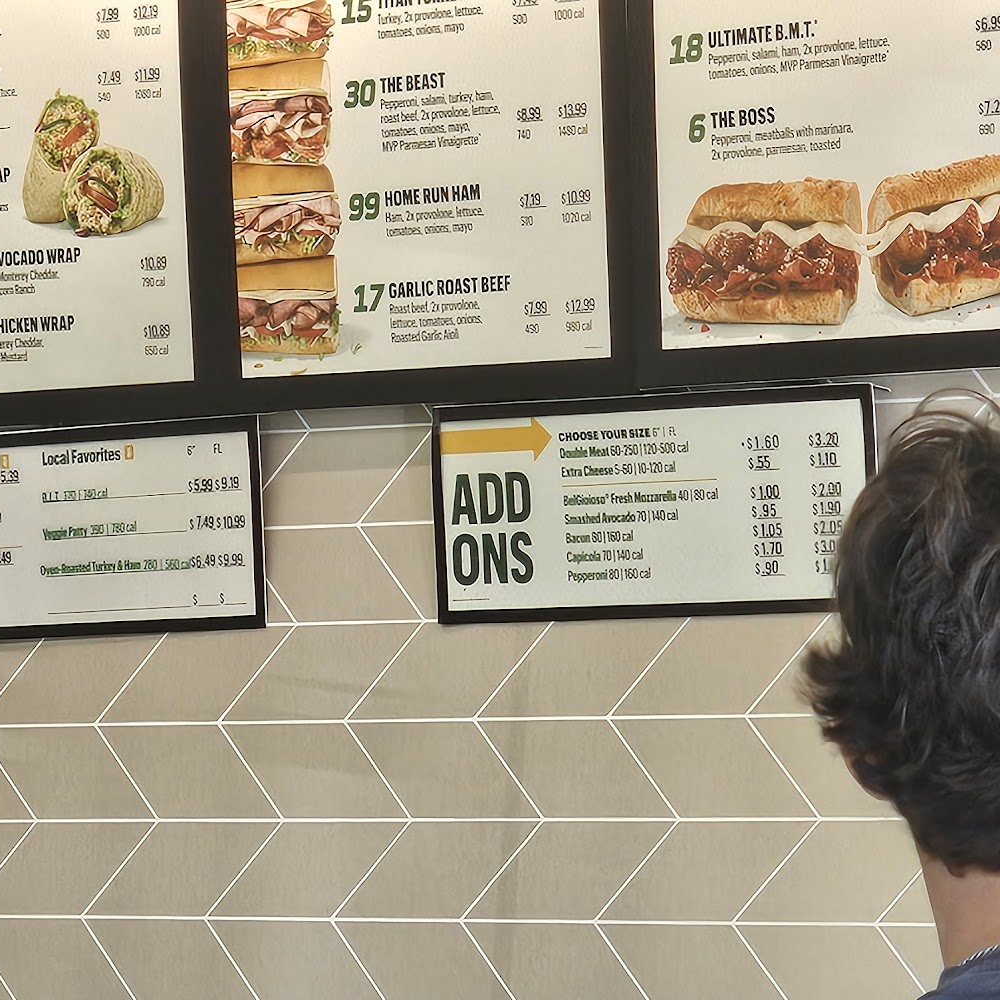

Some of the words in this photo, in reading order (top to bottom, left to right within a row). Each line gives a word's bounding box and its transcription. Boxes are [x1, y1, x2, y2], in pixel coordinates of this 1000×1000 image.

[96, 8, 119, 22] $7.99
[342, 0, 372, 24] 15
[669, 33, 704, 65] 18
[708, 25, 772, 49] ULTIMATE
[803, 44, 813, 55] 2x
[780, 61, 799, 73] MVP
[799, 58, 840, 70] Parmesan
[98, 70, 120, 85] $7.49
[135, 68, 160, 82] $11.99
[344, 79, 376, 109] 30
[380, 76, 403, 94] THE
[406, 72, 446, 91] BEAST
[517, 107, 541, 121] $8.99
[558, 103, 587, 118] $13.99
[688, 114, 706, 144] 6
[710, 111, 735, 129] THE
[738, 107, 775, 126] BOSS
[796, 126, 814, 138] with
[711, 149, 722, 161] 2x
[809, 138, 841, 151] toasted
[349, 192, 380, 221] 99
[385, 189, 420, 207] HOME
[423, 186, 449, 203] RUN
[452, 184, 480, 201] HAM
[561, 190, 591, 205] $10.99
[46, 247, 81, 264] WRAP
[353, 284, 385, 312] 17
[389, 281, 434, 299] GARLIC
[437, 277, 478, 295] ROAST
[481, 275, 511, 293] BEEF
[524, 301, 548, 316] $7.99
[566, 298, 595, 313] $12.99
[40, 315, 74, 332] WRAP
[558, 431, 598, 442] CHOOSE
[600, 430, 628, 440] YOUR
[629, 428, 650, 438] SIZE
[747, 435, 779, 450] $1.60
[808, 432, 839, 447] $3.20
[213, 443, 222, 454] FL
[677, 441, 689, 453] cal
[42, 449, 70, 466] Local
[71, 447, 121, 464] Favorites
[810, 452, 837, 467] $1.10
[561, 467, 582, 477] Extra
[583, 466, 614, 476] Cheese
[215, 476, 239, 491] $9.19
[452, 471, 531, 525] ADD
[610, 493, 633, 504] Fresh
[750, 485, 780, 499] $1.00
[602, 511, 636, 523] Avocado
[752, 504, 777, 518] $.95
[217, 514, 246, 530] $10.99
[753, 523, 782, 537] $1.05
[754, 542, 782, 556] $1.70
[190, 554, 216, 568] $6.49
[217, 553, 244, 567] $9.99
[453, 531, 534, 586] ONS
[755, 560, 778, 575] $.90
